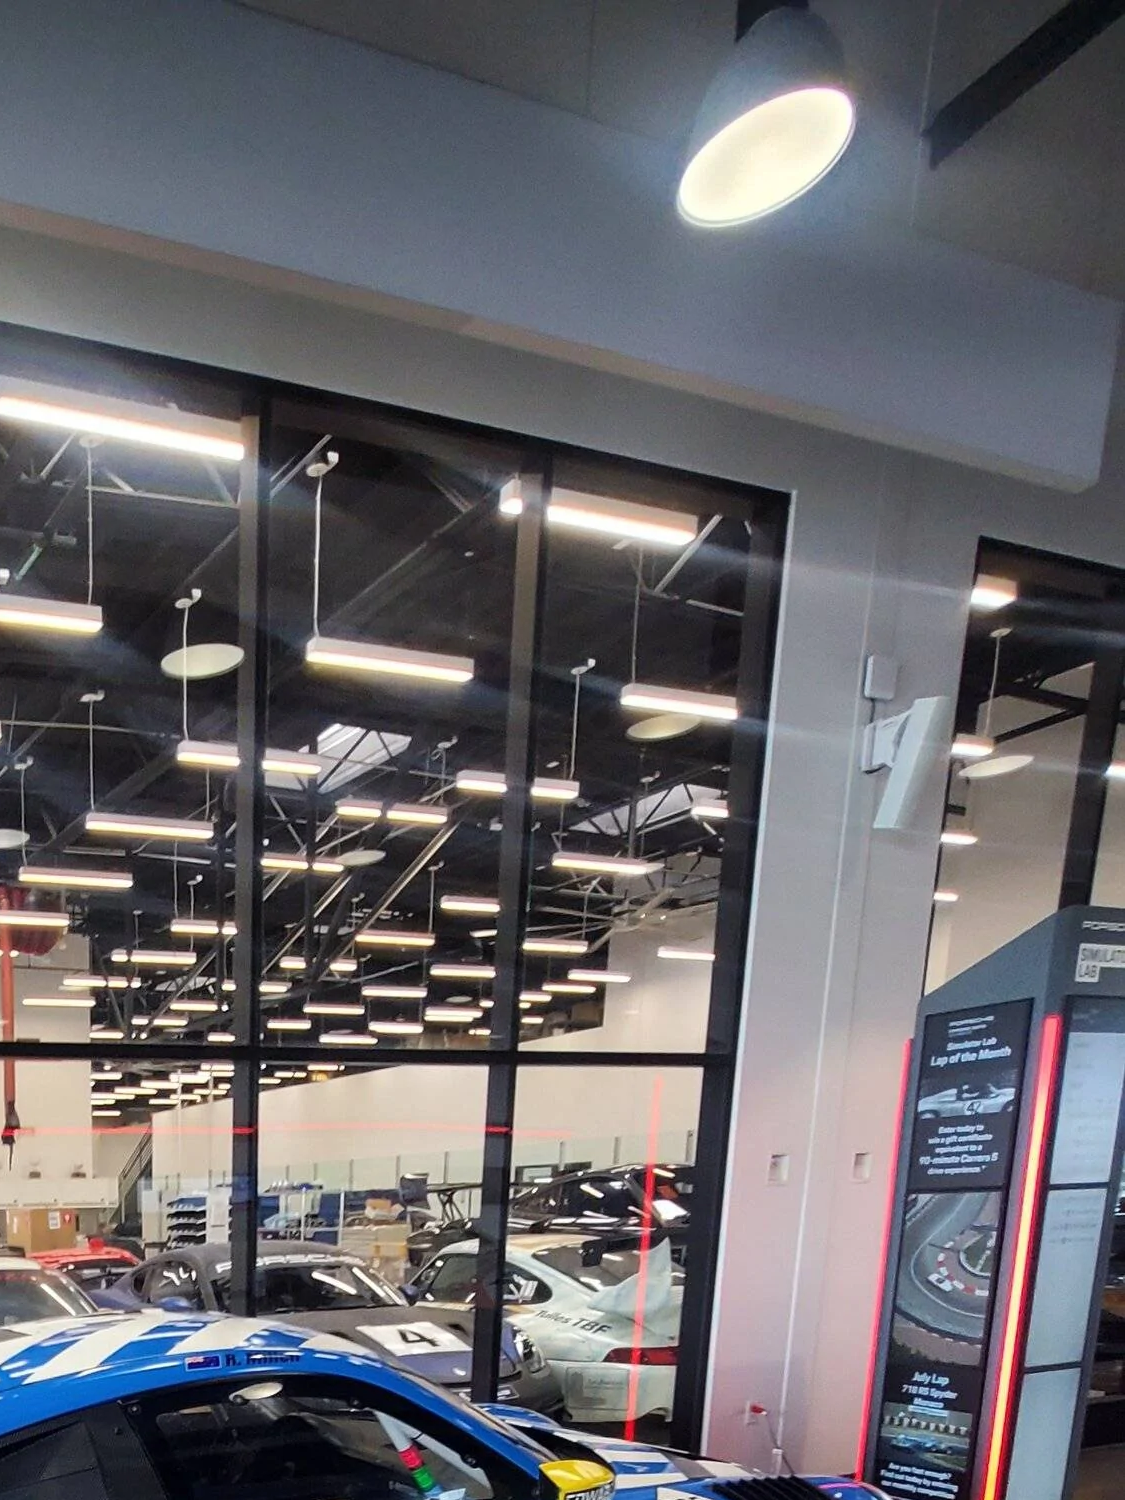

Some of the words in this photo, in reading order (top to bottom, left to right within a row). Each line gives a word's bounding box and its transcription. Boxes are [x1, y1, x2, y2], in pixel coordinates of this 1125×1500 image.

[1078, 964, 1097, 978] LAB
[930, 1056, 948, 1067] Lap
[949, 1052, 961, 1064] of
[961, 1051, 977, 1062] the
[977, 1046, 1012, 1060] Month
[215, 1254, 366, 1274] PRSCHE
[397, 1329, 440, 1347] 4
[932, 1374, 949, 1387] Lap
